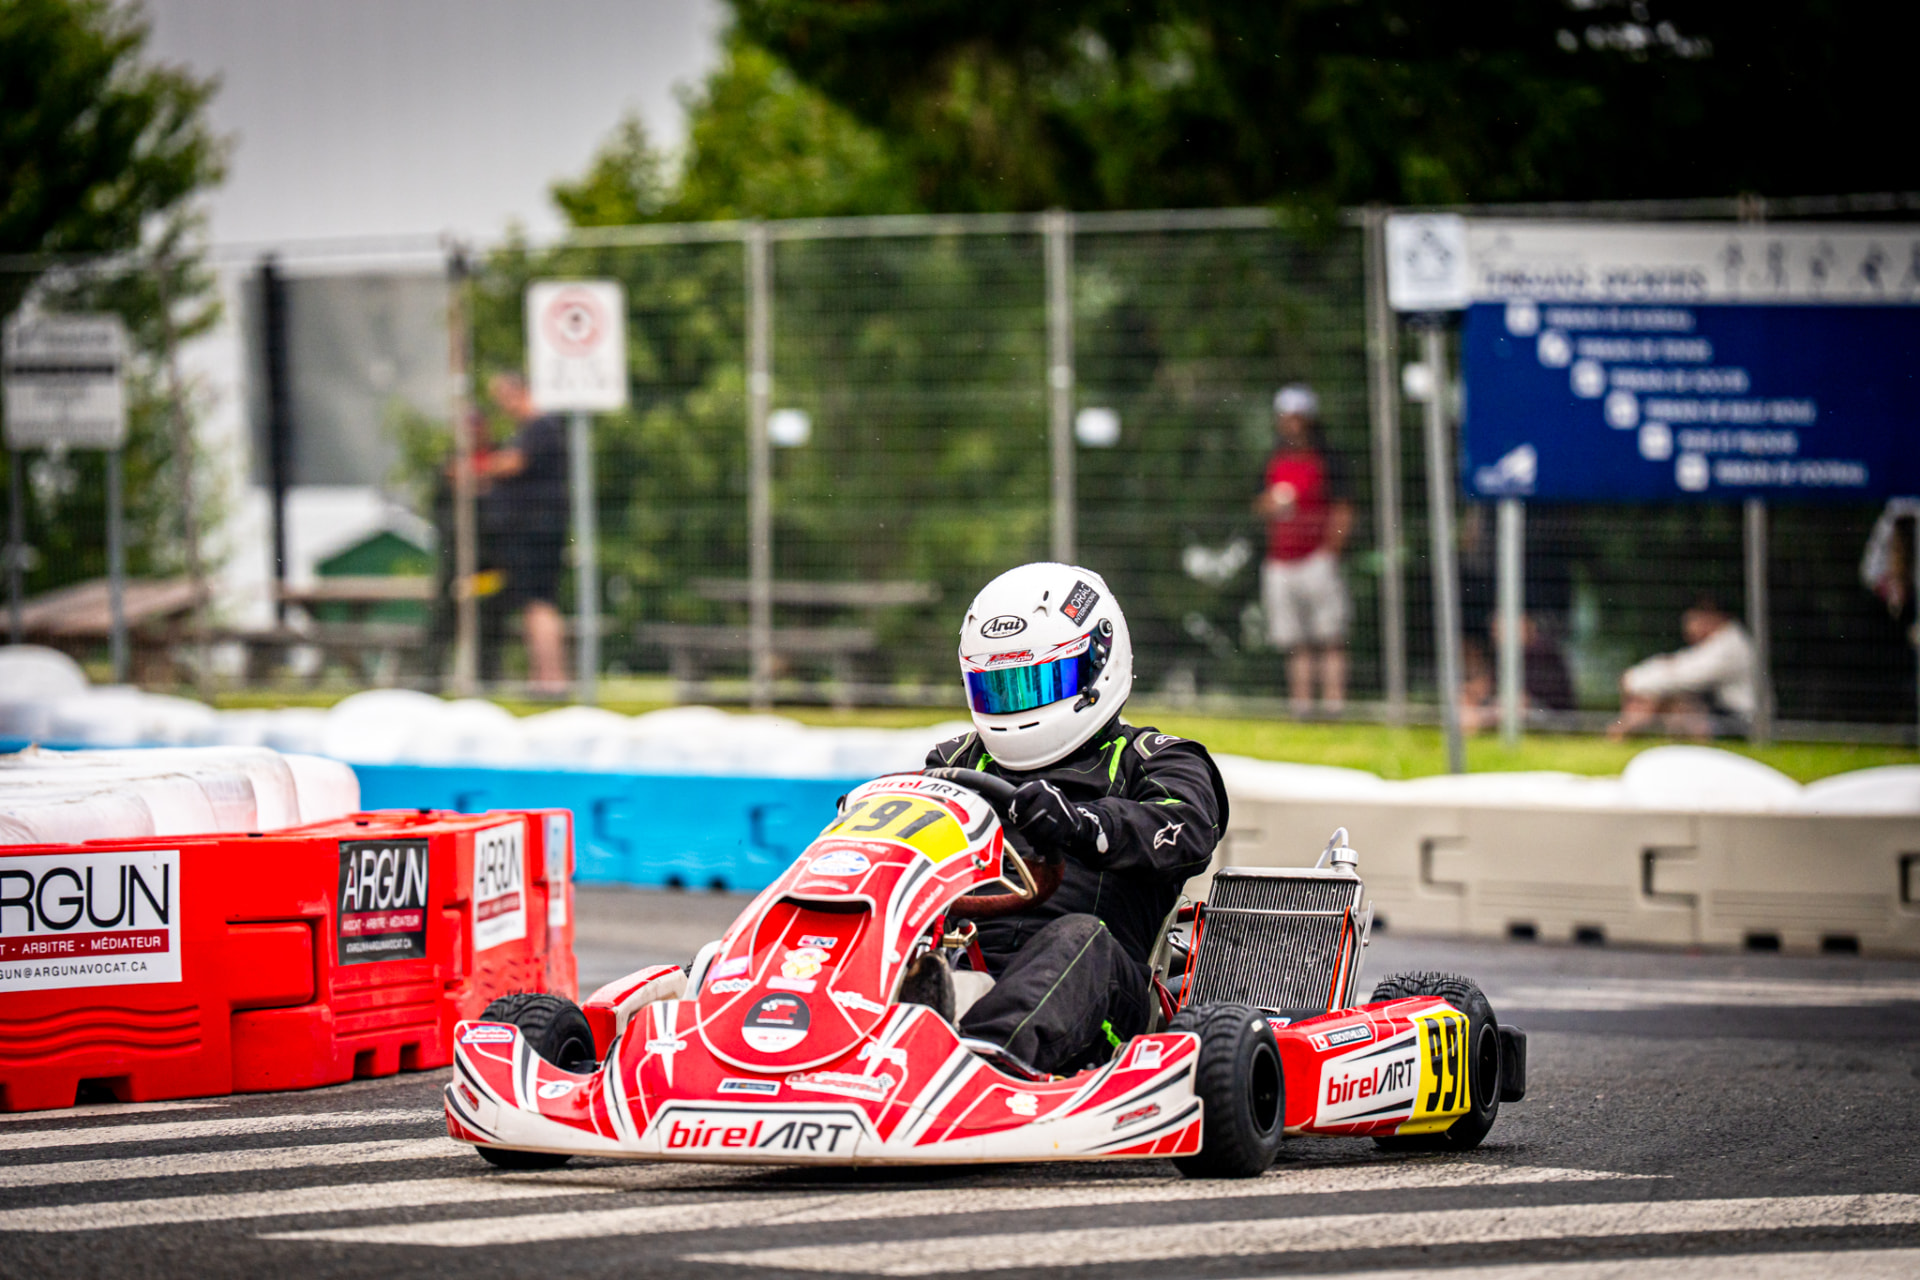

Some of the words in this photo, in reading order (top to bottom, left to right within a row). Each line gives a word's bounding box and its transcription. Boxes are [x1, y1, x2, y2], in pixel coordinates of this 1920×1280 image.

[984, 618, 1021, 633] Arai
[342, 847, 427, 911] ARGUN
[22, 940, 75, 955] ARBITRE
[91, 936, 161, 950] MÉDIATEUR
[1327, 1057, 1416, 1106] birelART
[1424, 1015, 1466, 1112] 991
[667, 1119, 853, 1152] birelART
